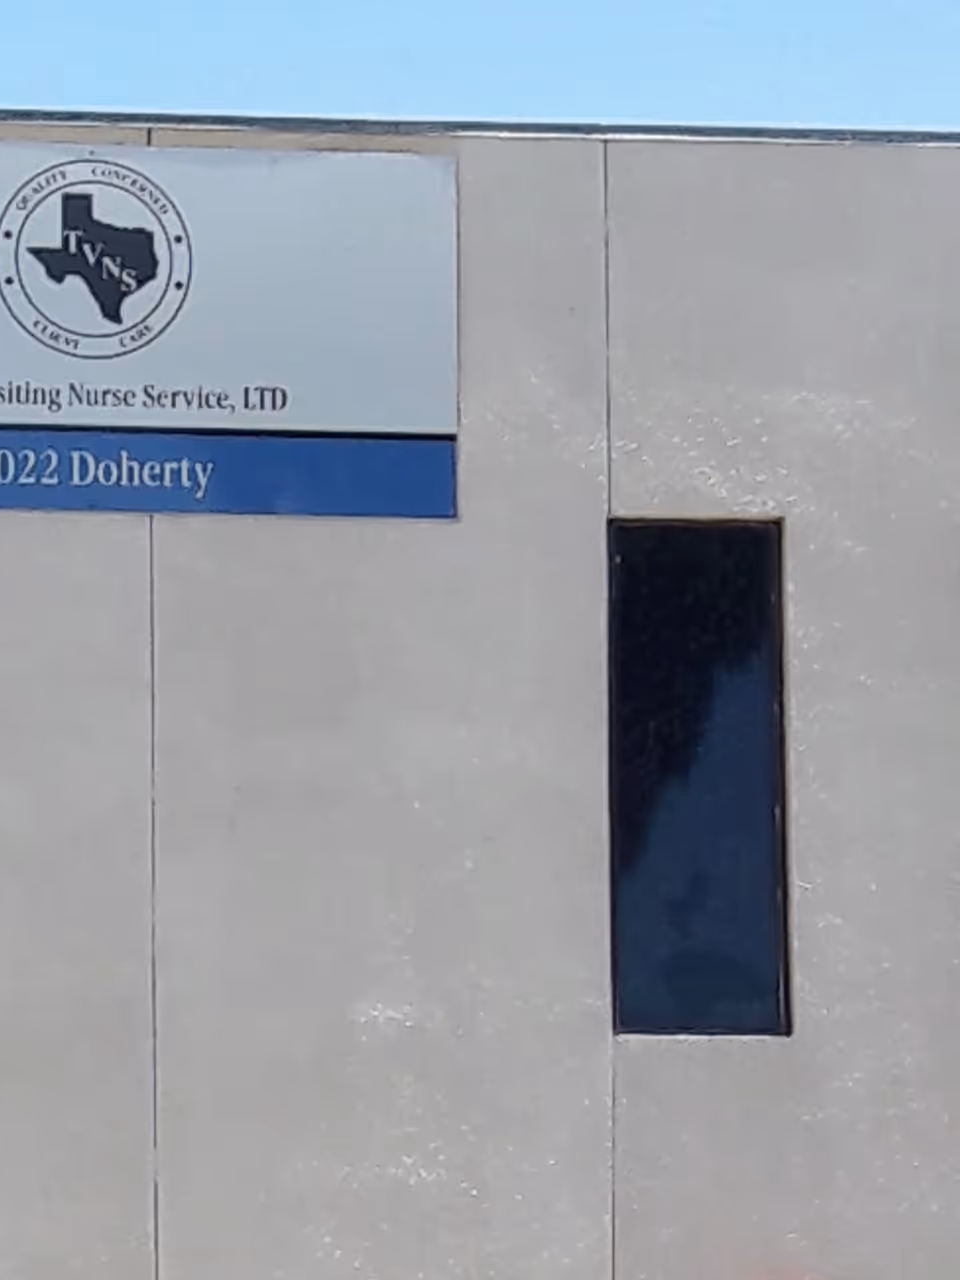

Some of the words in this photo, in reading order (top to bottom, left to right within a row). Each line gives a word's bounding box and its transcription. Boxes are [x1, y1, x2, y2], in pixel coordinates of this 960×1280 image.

[16, 169, 68, 211] QUALITY
[64, 229, 138, 292] TVNS
[118, 323, 154, 348] CARE
[67, 381, 137, 407] Nurse
[141, 383, 236, 413] Service,
[243, 386, 288, 411] LTD
[70, 449, 214, 498] Doherty
